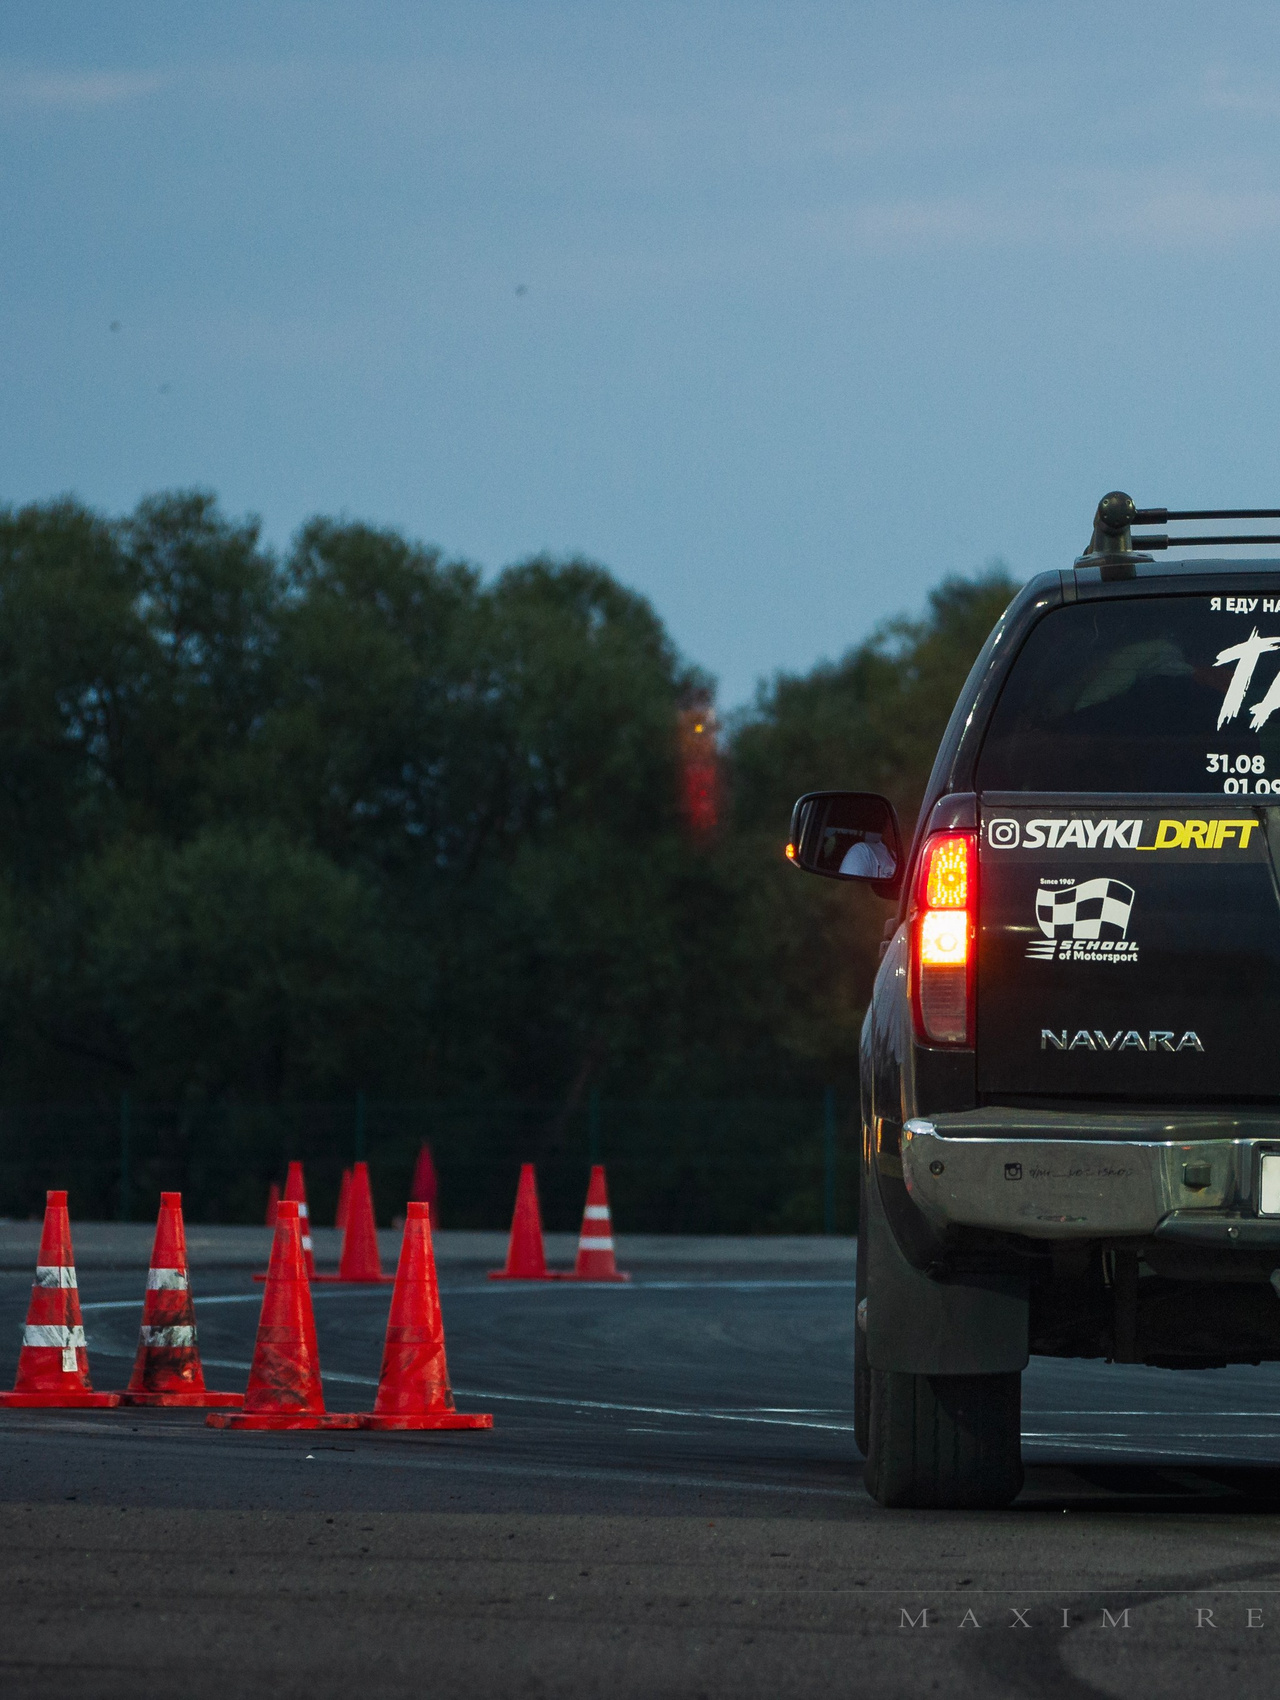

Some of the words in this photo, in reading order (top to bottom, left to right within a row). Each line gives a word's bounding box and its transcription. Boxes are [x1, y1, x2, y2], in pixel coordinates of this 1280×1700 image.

[1210, 597, 1221, 612] Я
[1226, 598, 1258, 613] ЕДУ
[1206, 754, 1266, 775] 31.08
[1022, 819, 1259, 851] STAYKI_DRIFT
[1059, 940, 1139, 951] SCHOOL
[1058, 950, 1072, 960] of
[1073, 950, 1138, 963] Motorsport
[1041, 1029, 1205, 1052] NAVARA
